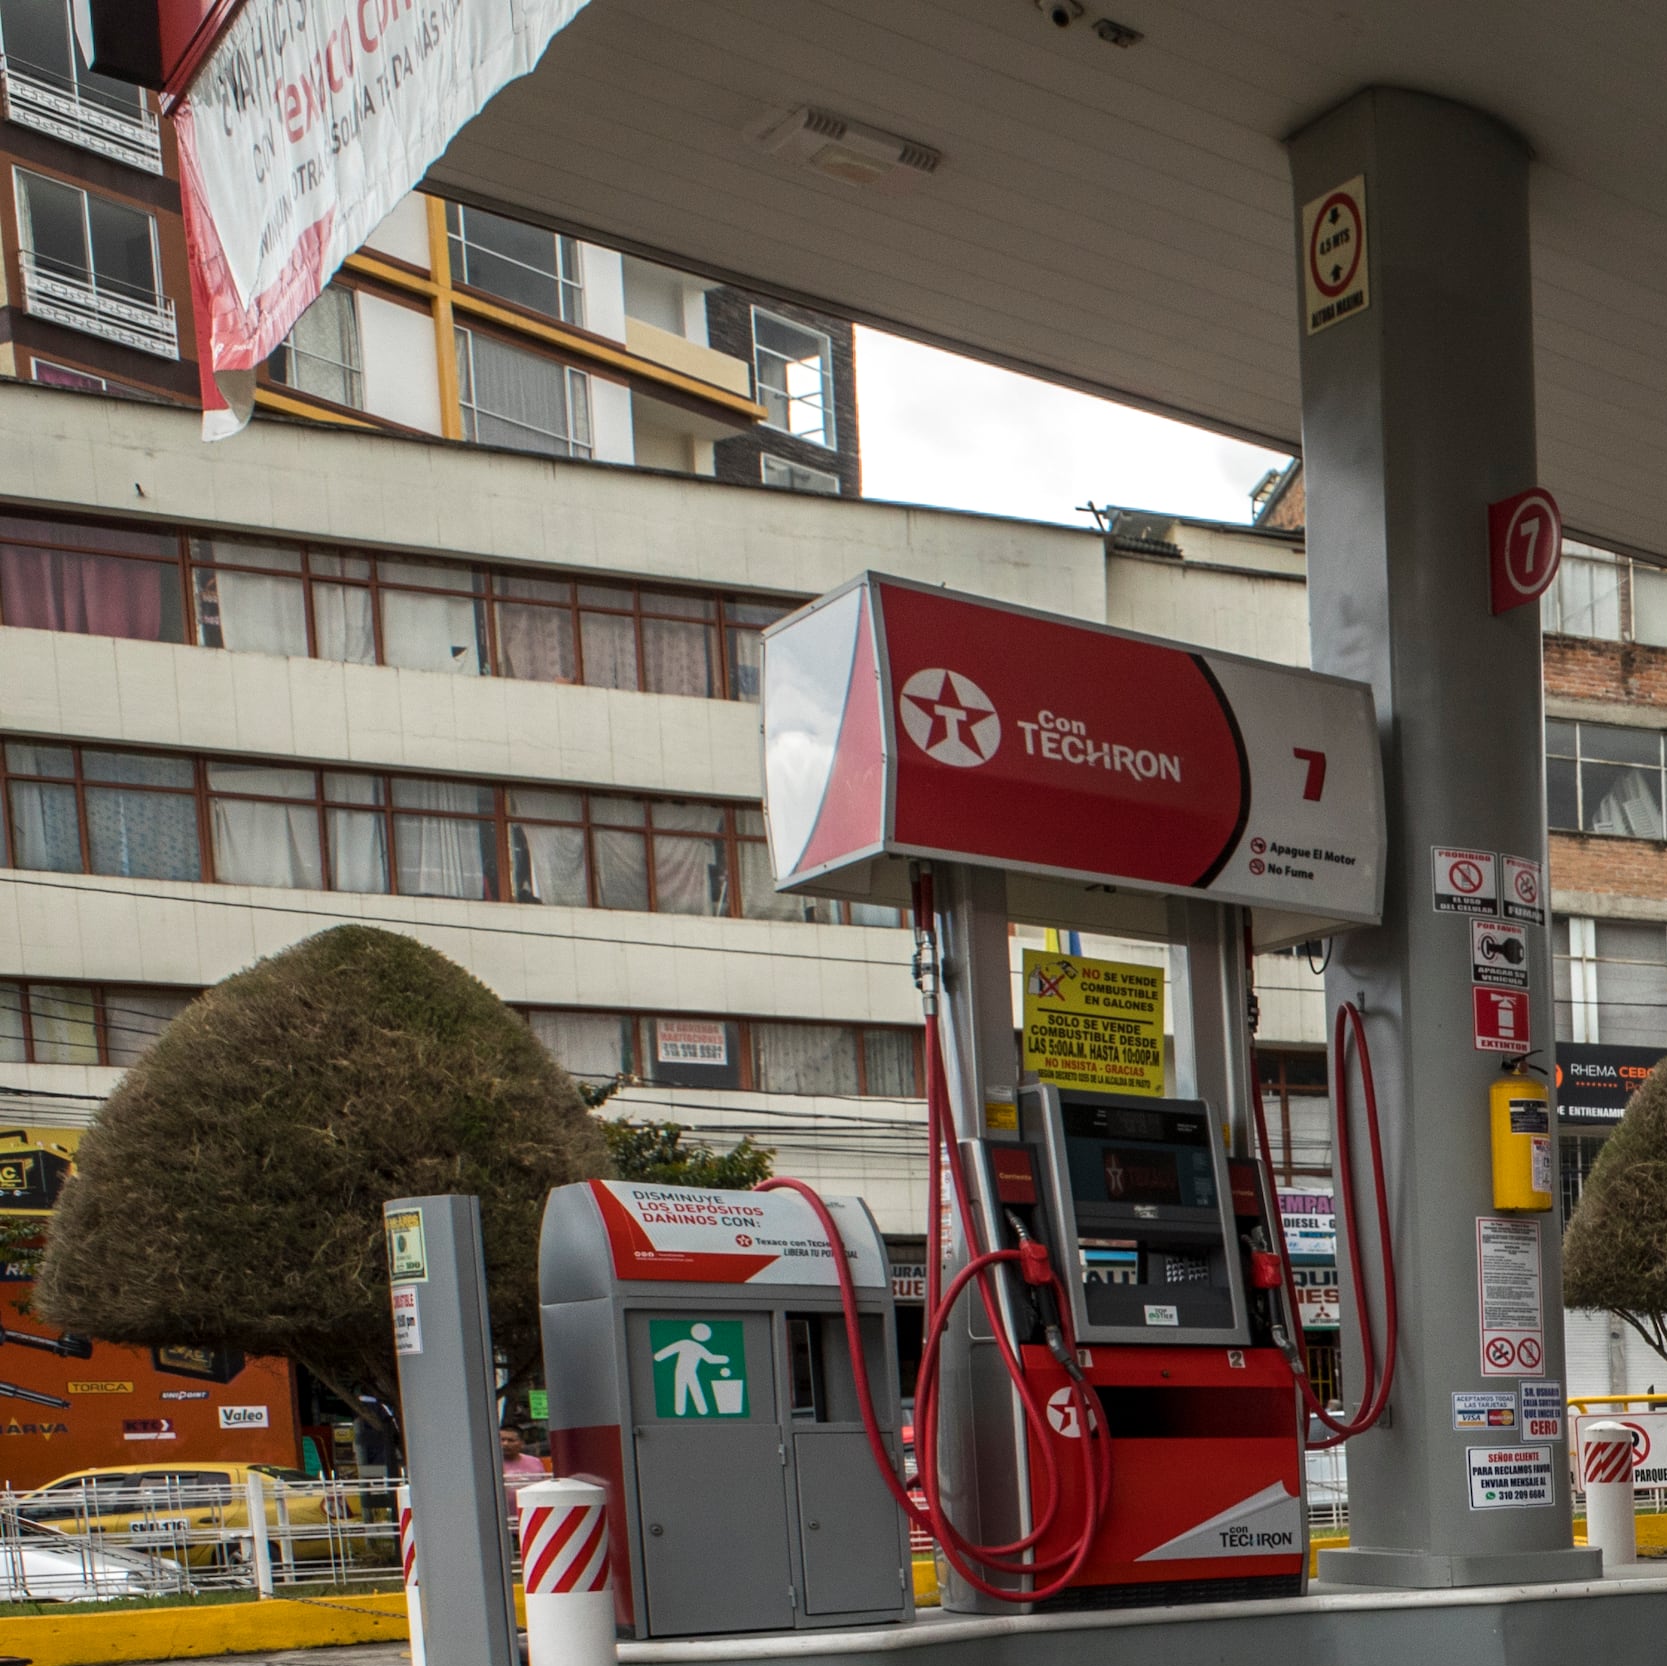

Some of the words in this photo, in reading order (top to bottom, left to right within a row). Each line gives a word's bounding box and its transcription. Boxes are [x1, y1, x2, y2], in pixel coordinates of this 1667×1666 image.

[1333, 227, 1351, 250] MTS
[1519, 517, 1541, 575] 7
[1038, 709, 1087, 736] Con
[1017, 720, 1182, 783] TECHRON
[1293, 747, 1328, 802] 7
[1270, 841, 1311, 862] Apague
[1312, 848, 1323, 861] El
[1323, 849, 1356, 867] Motor
[1438, 850, 1491, 862] PROHIBIDO
[1268, 863, 1283, 876] No
[1285, 864, 1315, 881] Fume
[1082, 967, 1101, 980] NO
[1104, 972, 1118, 982] SE
[1120, 974, 1158, 988] VENDE
[1080, 982, 1159, 1000] COMBUSTIBLE
[1084, 995, 1100, 1006] EN
[1103, 998, 1155, 1012] GALONES
[1048, 1014, 1080, 1028] SOLO
[1083, 1018, 1099, 1030] SE
[1102, 1022, 1141, 1036] VENDE
[1031, 1025, 1116, 1045] COMBUSTIBLE
[1119, 1035, 1157, 1049] DESDE
[1028, 1037, 1047, 1054] LAS
[1089, 1044, 1120, 1063] HASTA
[1481, 1039, 1528, 1052] EXTINTOR
[1045, 1057, 1059, 1068] NO
[1061, 1059, 1098, 1072] INSISTA
[1104, 1064, 1145, 1077] GRACIAS
[1570, 1063, 1617, 1078] RHEMA
[633, 1190, 723, 1204] DISMINUYE
[638, 1201, 671, 1212] LOS
[675, 1201, 764, 1217] DEPÓSITOS
[643, 1209, 718, 1226] DAÑINOS
[721, 1216, 761, 1228] CON:
[1284, 1217, 1320, 1229] DIESEL
[756, 1237, 787, 1247] Texaco
[784, 1248, 810, 1257] LIBERA
[810, 1248, 822, 1257] TU
[1077, 1350, 1087, 1366] 1
[1230, 1351, 1243, 1367] 2
[71, 1382, 128, 1393] TORICA
[222, 1407, 264, 1423] Valeo
[1462, 1414, 1482, 1422] VISA
[1524, 1409, 1537, 1419] QUE
[1530, 1420, 1558, 1436] CERO
[1488, 1450, 1513, 1463] SEÑOR
[1514, 1451, 1541, 1462] CLIENTE
[1472, 1466, 1494, 1476] PARA
[1494, 1465, 1533, 1476] RECLAMOS
[1481, 1478, 1509, 1489] ENVIAR
[1510, 1477, 1540, 1488] MENSAJE
[1540, 1476, 1547, 1486] AL
[1498, 1491, 1513, 1501] 310
[1514, 1490, 1529, 1500] 209
[1229, 1526, 1249, 1534] con
